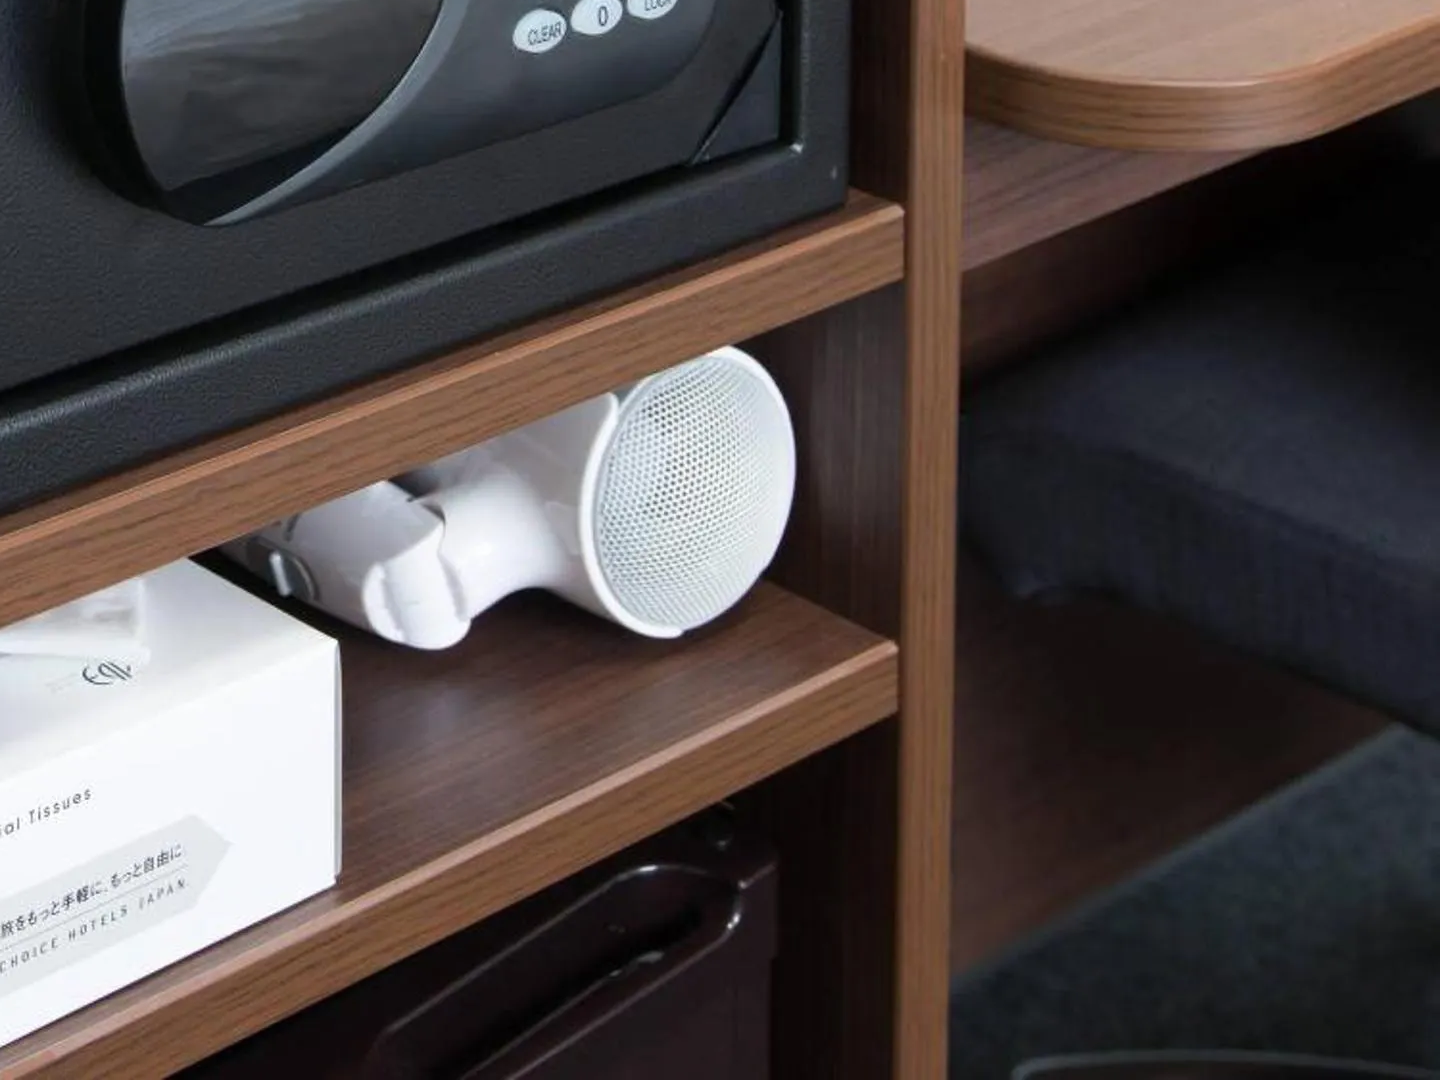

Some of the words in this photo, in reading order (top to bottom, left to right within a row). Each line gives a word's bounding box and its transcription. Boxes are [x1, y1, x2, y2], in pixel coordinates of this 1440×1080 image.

[527, 21, 561, 46] CLEAR
[597, 5, 609, 27] 0
[28, 788, 92, 825] Tissues
[67, 904, 129, 942] HOTELS
[137, 877, 187, 911] JAPAN
